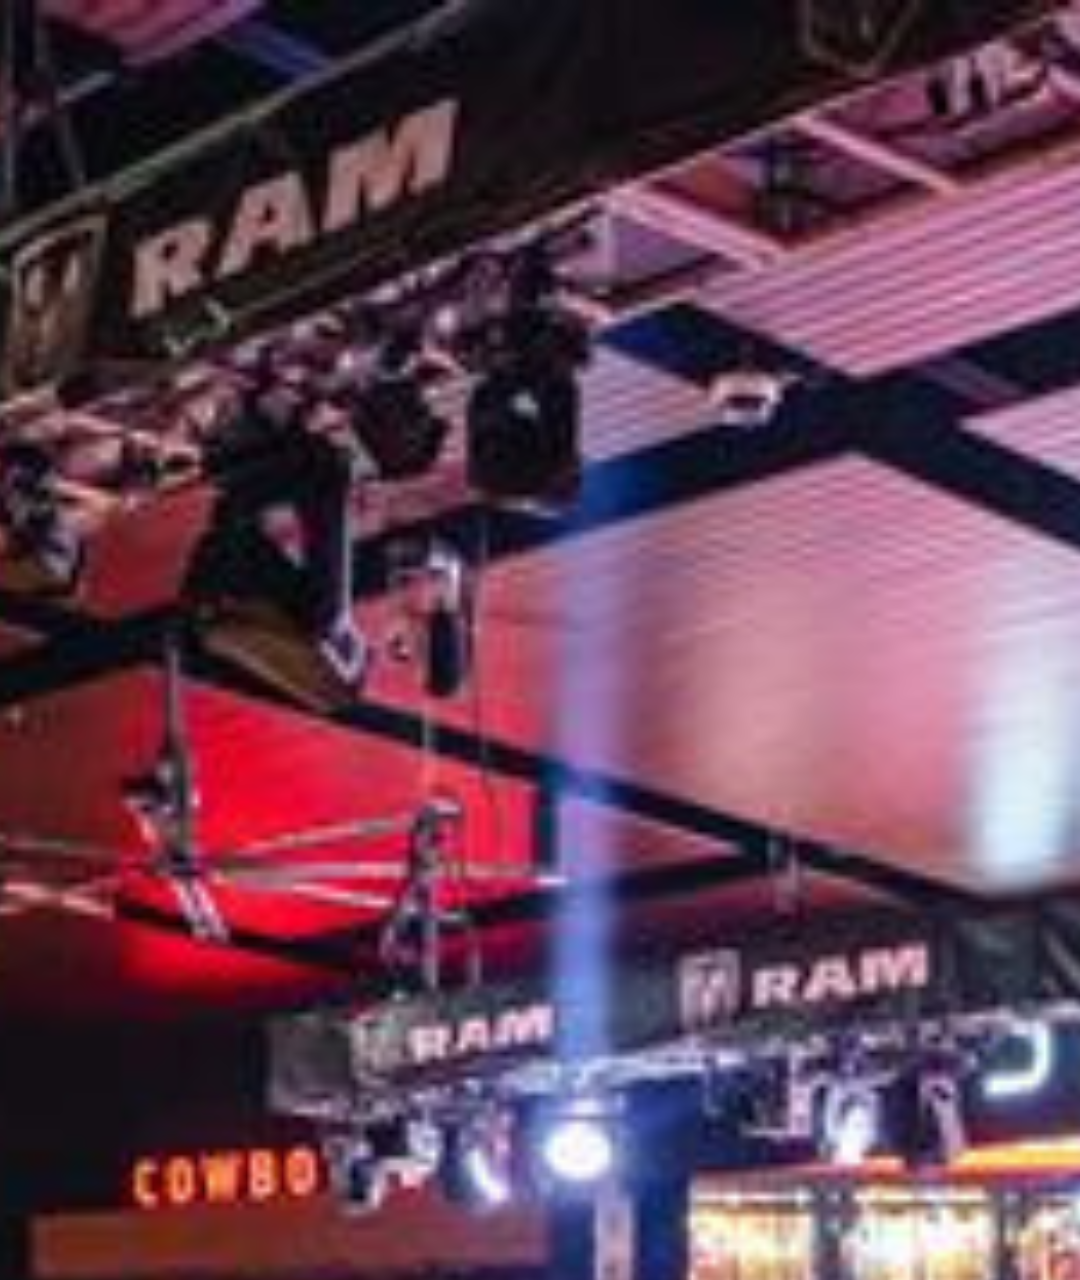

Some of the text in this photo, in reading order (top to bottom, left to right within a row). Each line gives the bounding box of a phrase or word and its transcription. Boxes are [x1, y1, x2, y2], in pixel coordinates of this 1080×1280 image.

[129, 100, 459, 319] RAM
[751, 945, 928, 1006] RAM
[407, 1006, 555, 1061] RAM
